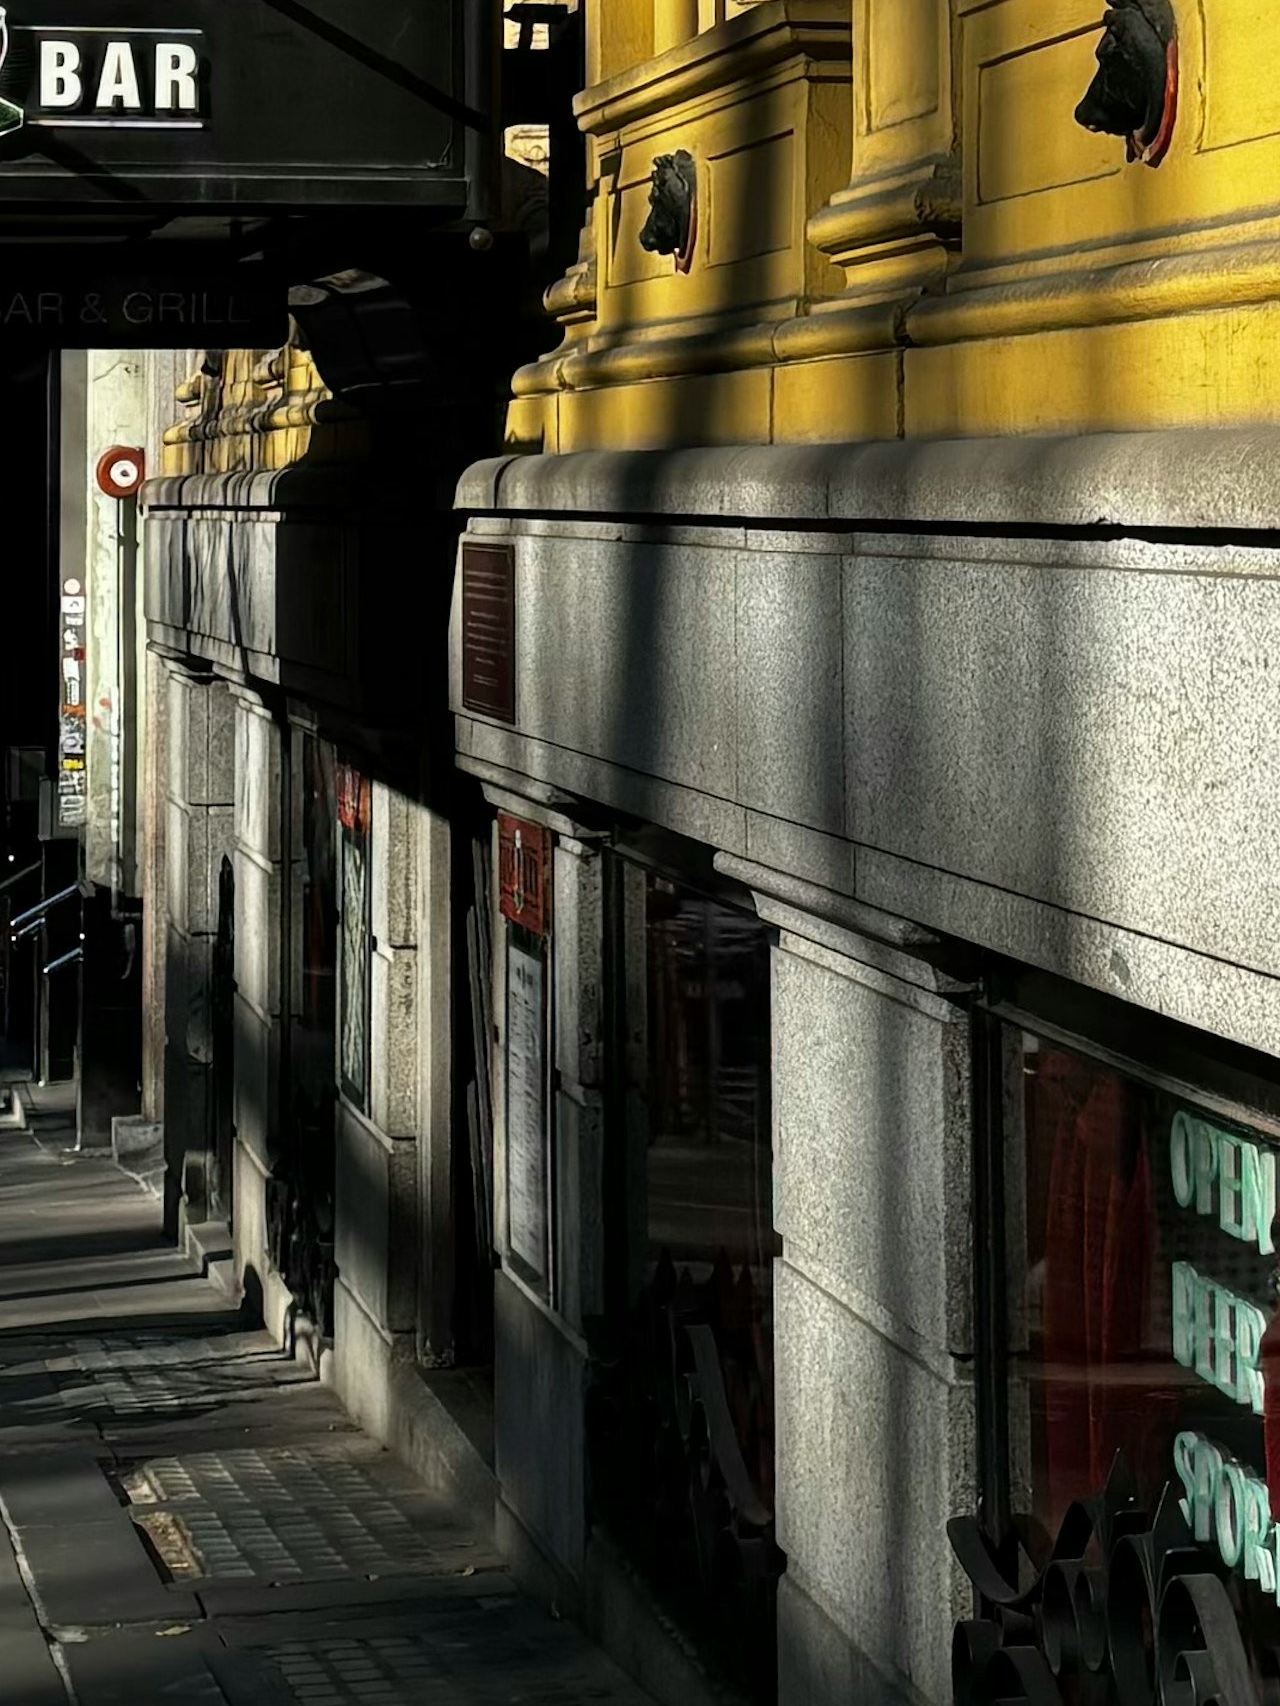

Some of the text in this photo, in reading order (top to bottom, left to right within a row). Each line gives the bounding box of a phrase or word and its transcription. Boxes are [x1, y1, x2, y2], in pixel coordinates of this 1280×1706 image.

[39, 40, 197, 111] BAR
[79, 292, 109, 324] &
[122, 291, 251, 325] GRILL
[1170, 1109, 1276, 1256] OPEN
[1172, 1260, 1268, 1416] BEER
